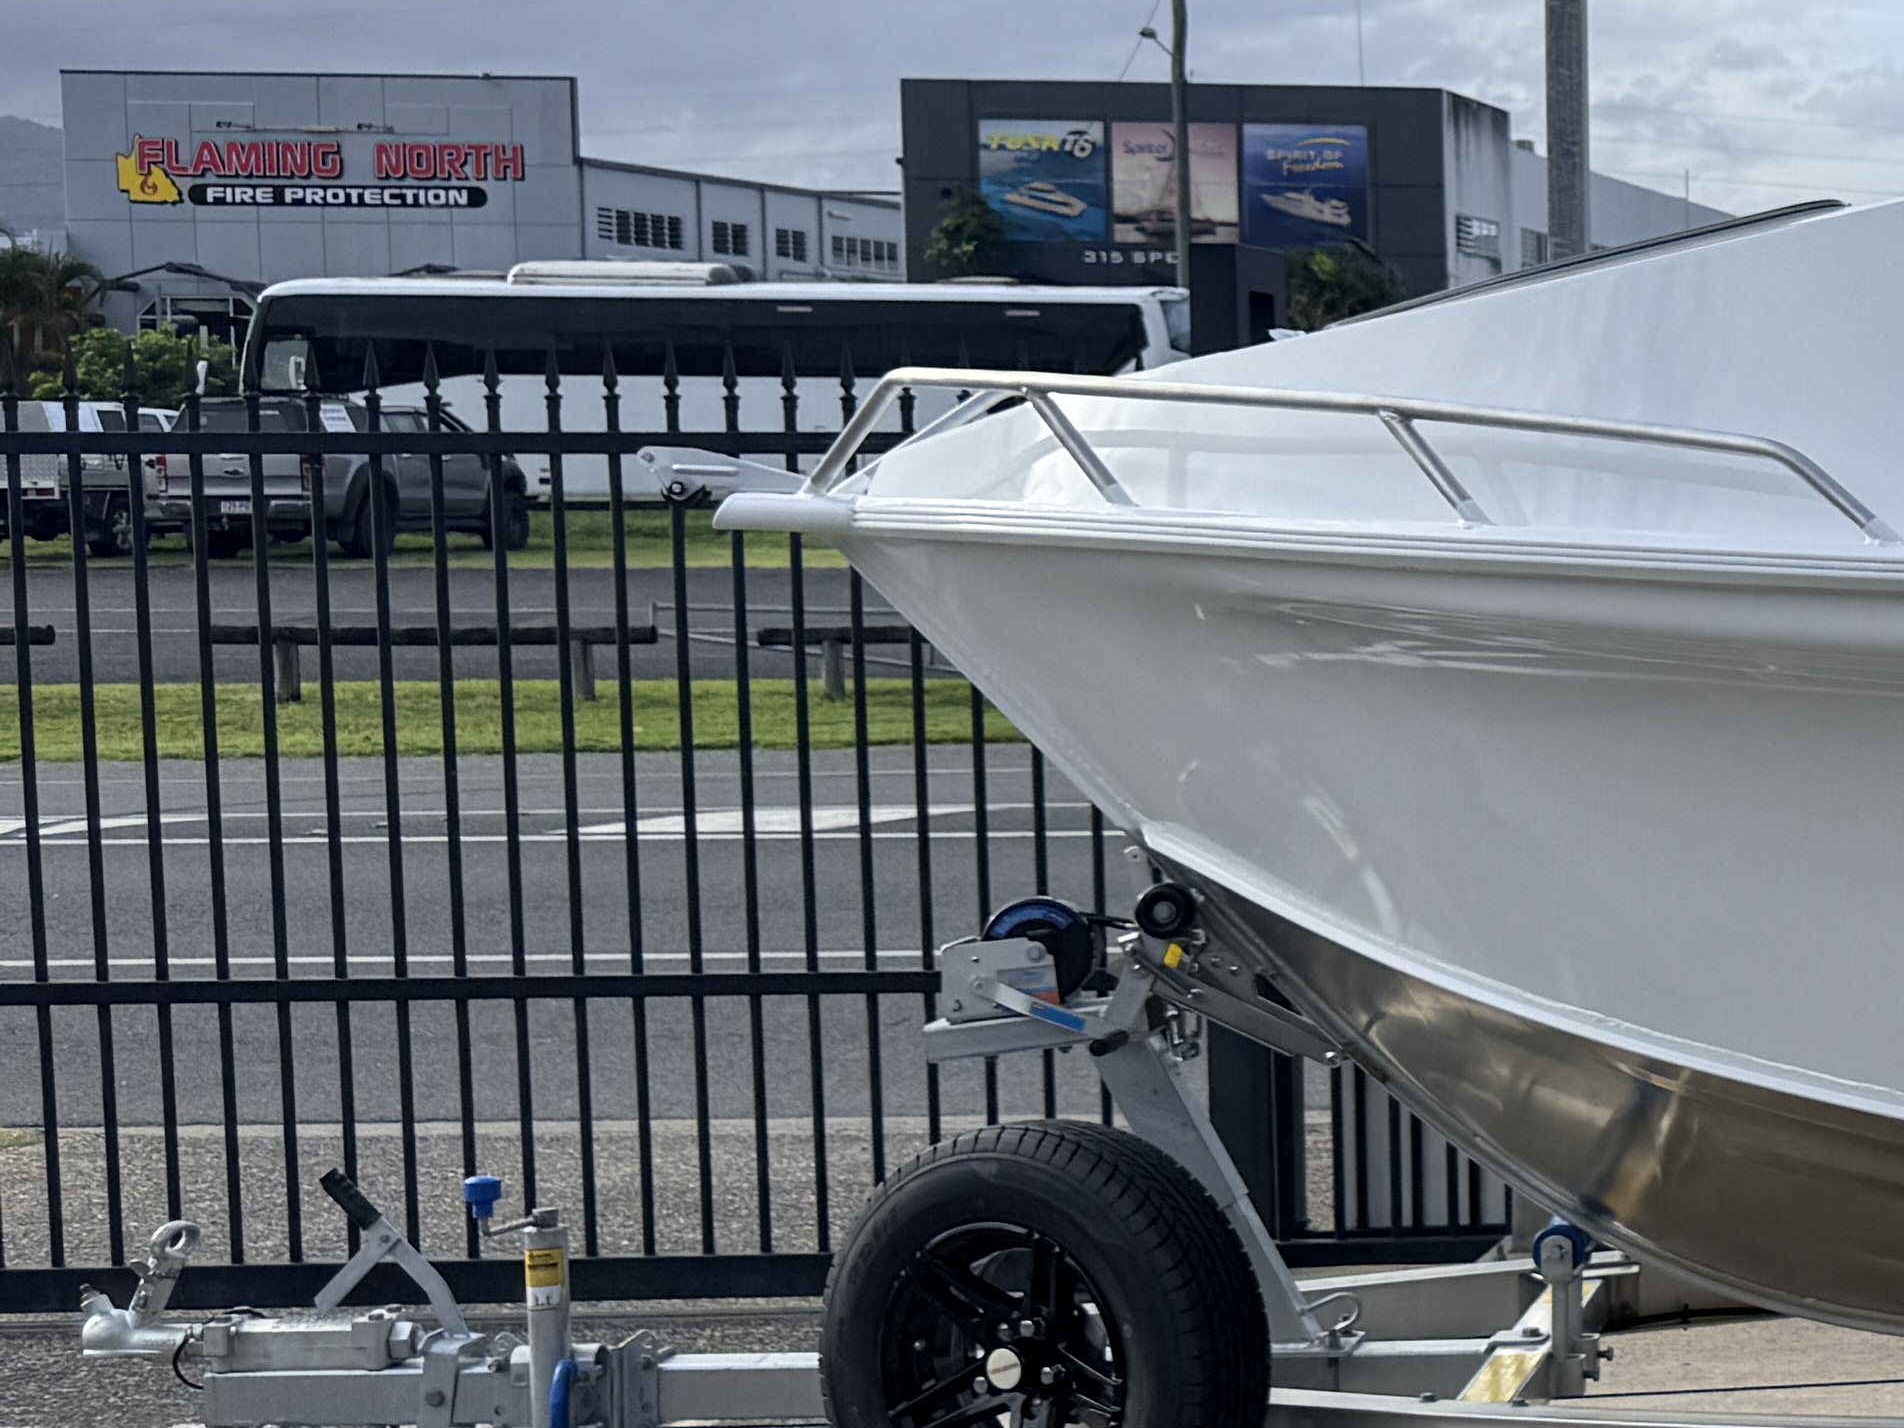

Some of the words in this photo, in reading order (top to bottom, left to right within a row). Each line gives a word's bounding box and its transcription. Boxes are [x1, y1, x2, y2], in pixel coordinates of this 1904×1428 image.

[137, 139, 340, 180] FLAMING
[374, 142, 524, 181] NORTH
[205, 187, 275, 204] FIRE
[284, 187, 469, 206] PROTECTION
